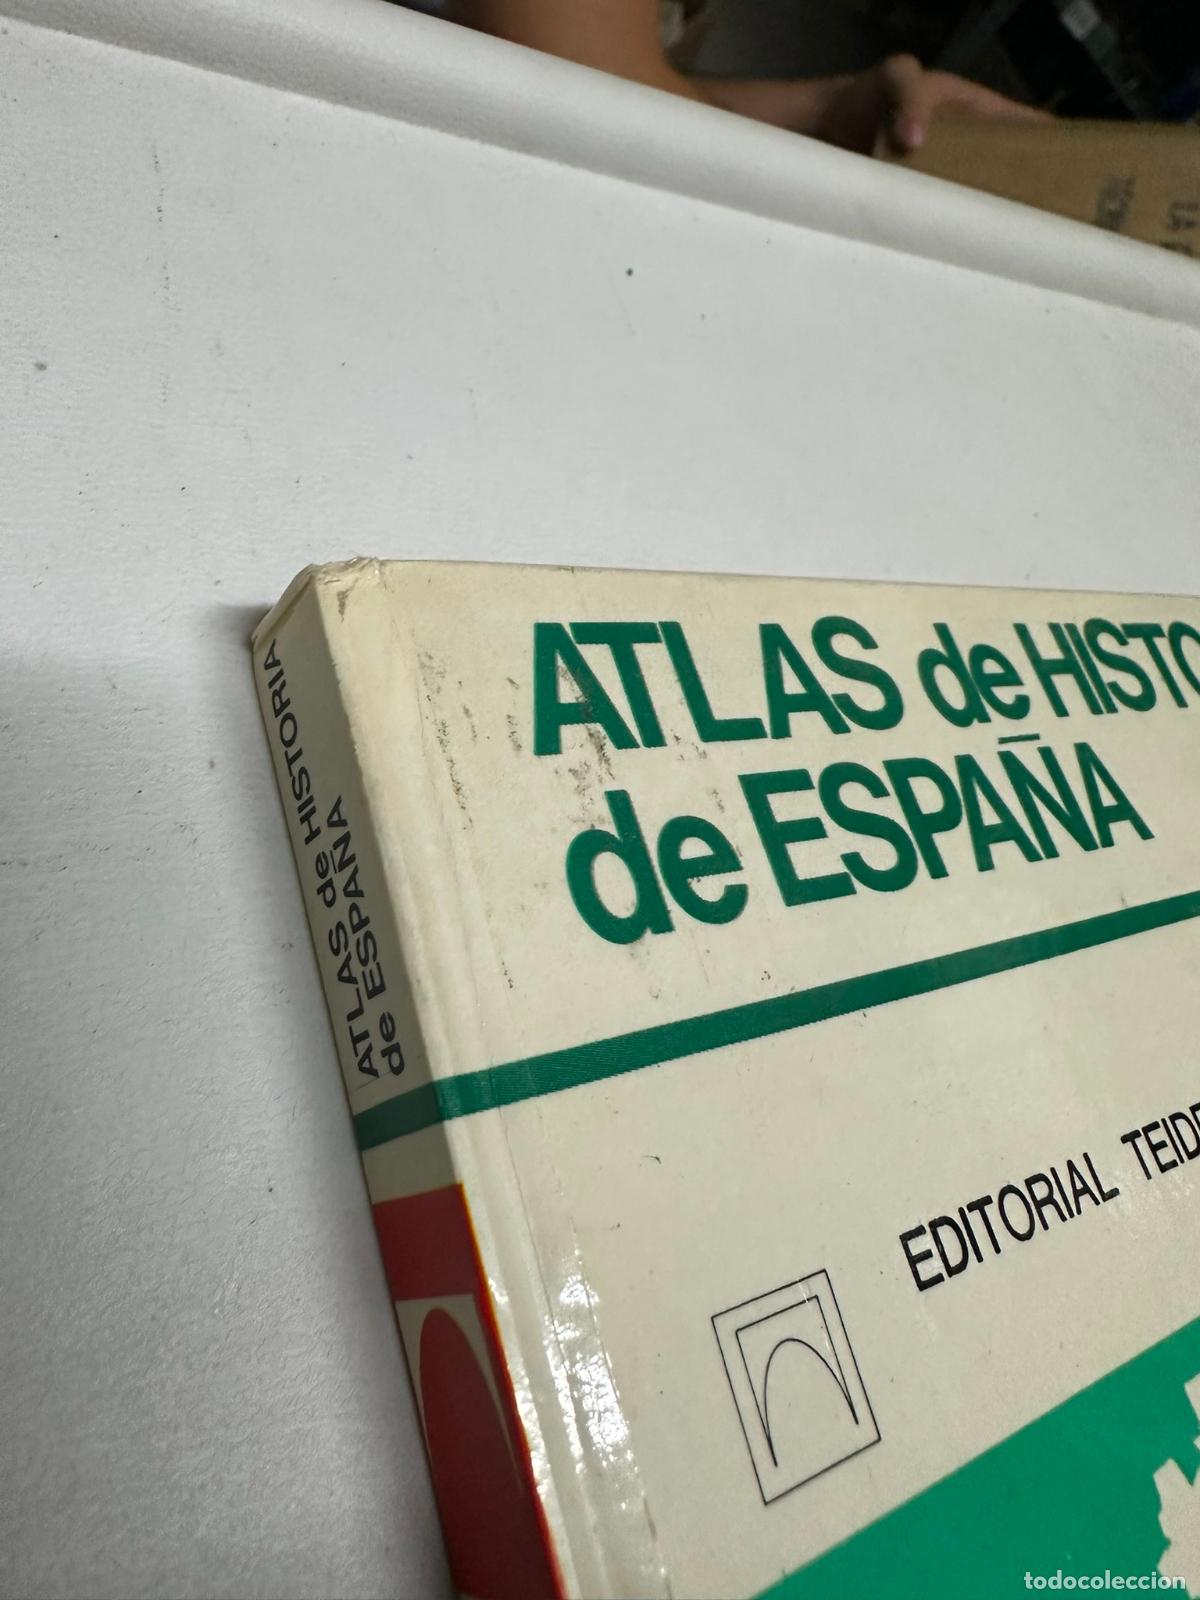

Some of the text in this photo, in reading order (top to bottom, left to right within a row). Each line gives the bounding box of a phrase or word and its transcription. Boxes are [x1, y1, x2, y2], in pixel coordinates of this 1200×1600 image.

[534, 615, 905, 756] ATLAS
[917, 622, 1031, 728] de
[263, 638, 380, 1079] ATLAS de HISTORIA
[326, 794, 406, 1077] de ESPAÑA
[565, 732, 1155, 945] de ESPAÑA
[899, 1151, 1120, 1292] EDITORIAL
